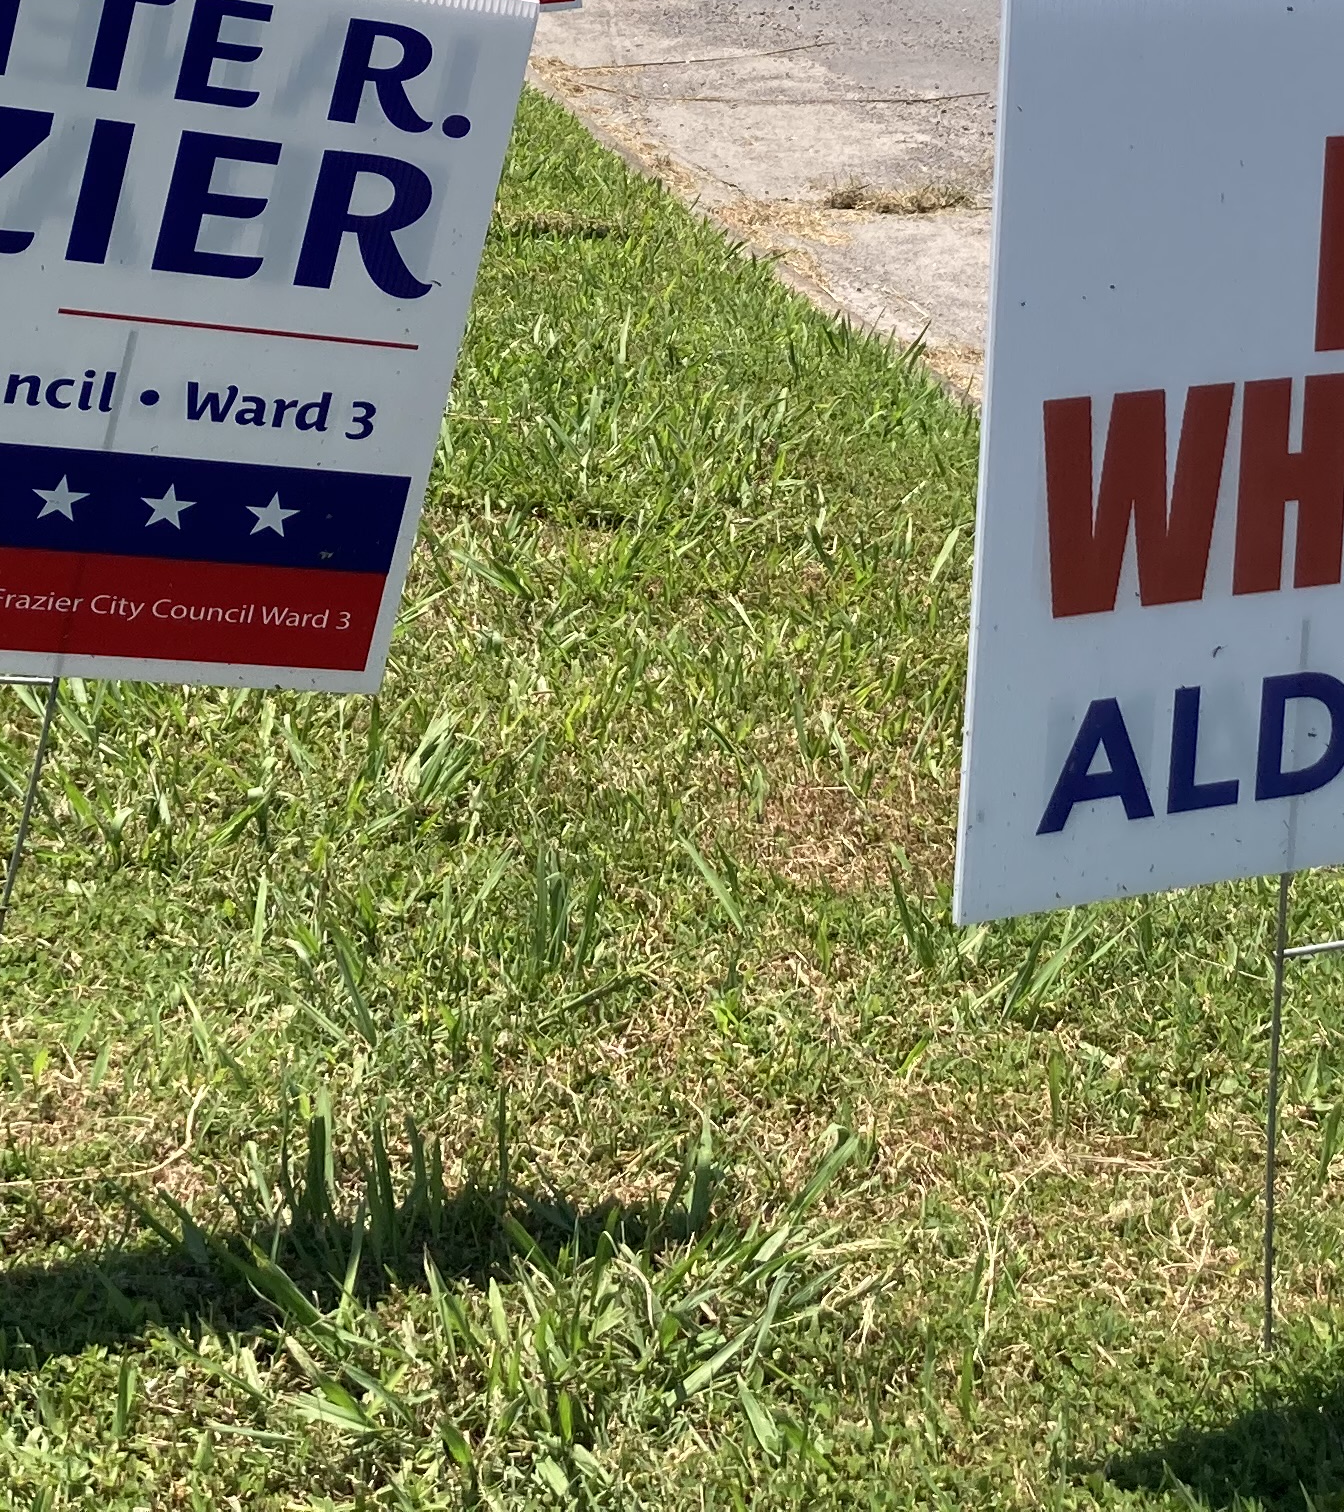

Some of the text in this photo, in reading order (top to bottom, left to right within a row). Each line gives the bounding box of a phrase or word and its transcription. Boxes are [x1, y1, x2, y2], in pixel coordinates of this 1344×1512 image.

[326, 17, 471, 139] R.
[186, 381, 333, 432] Ward
[344, 401, 377, 441] 3
[90, 594, 146, 622] City
[152, 598, 255, 624] Council
[262, 605, 330, 629] Ward
[335, 611, 351, 630] 3
